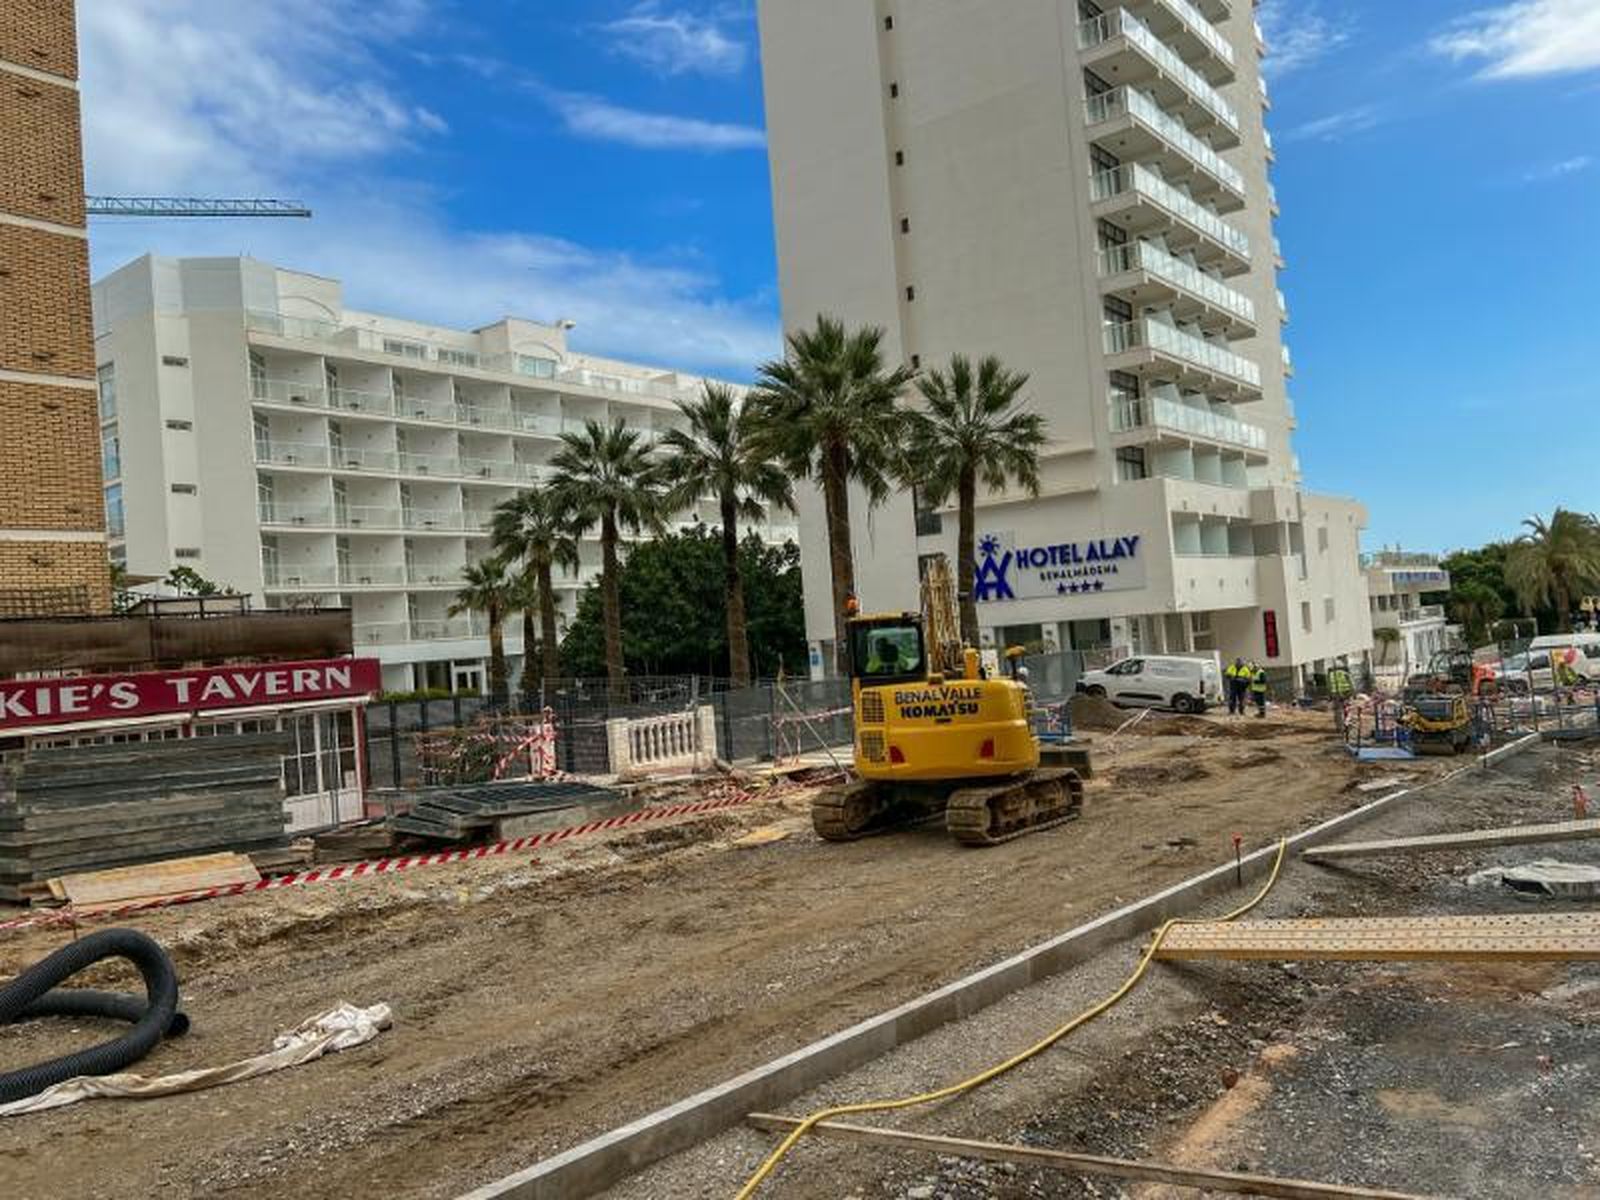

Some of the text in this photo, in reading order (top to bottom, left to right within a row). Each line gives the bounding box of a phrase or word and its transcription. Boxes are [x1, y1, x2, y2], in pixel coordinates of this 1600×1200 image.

[1015, 535, 1140, 570] HOTEL ALAY
[165, 665, 352, 704] TAVERN
[900, 701, 979, 719] KOMATSU
